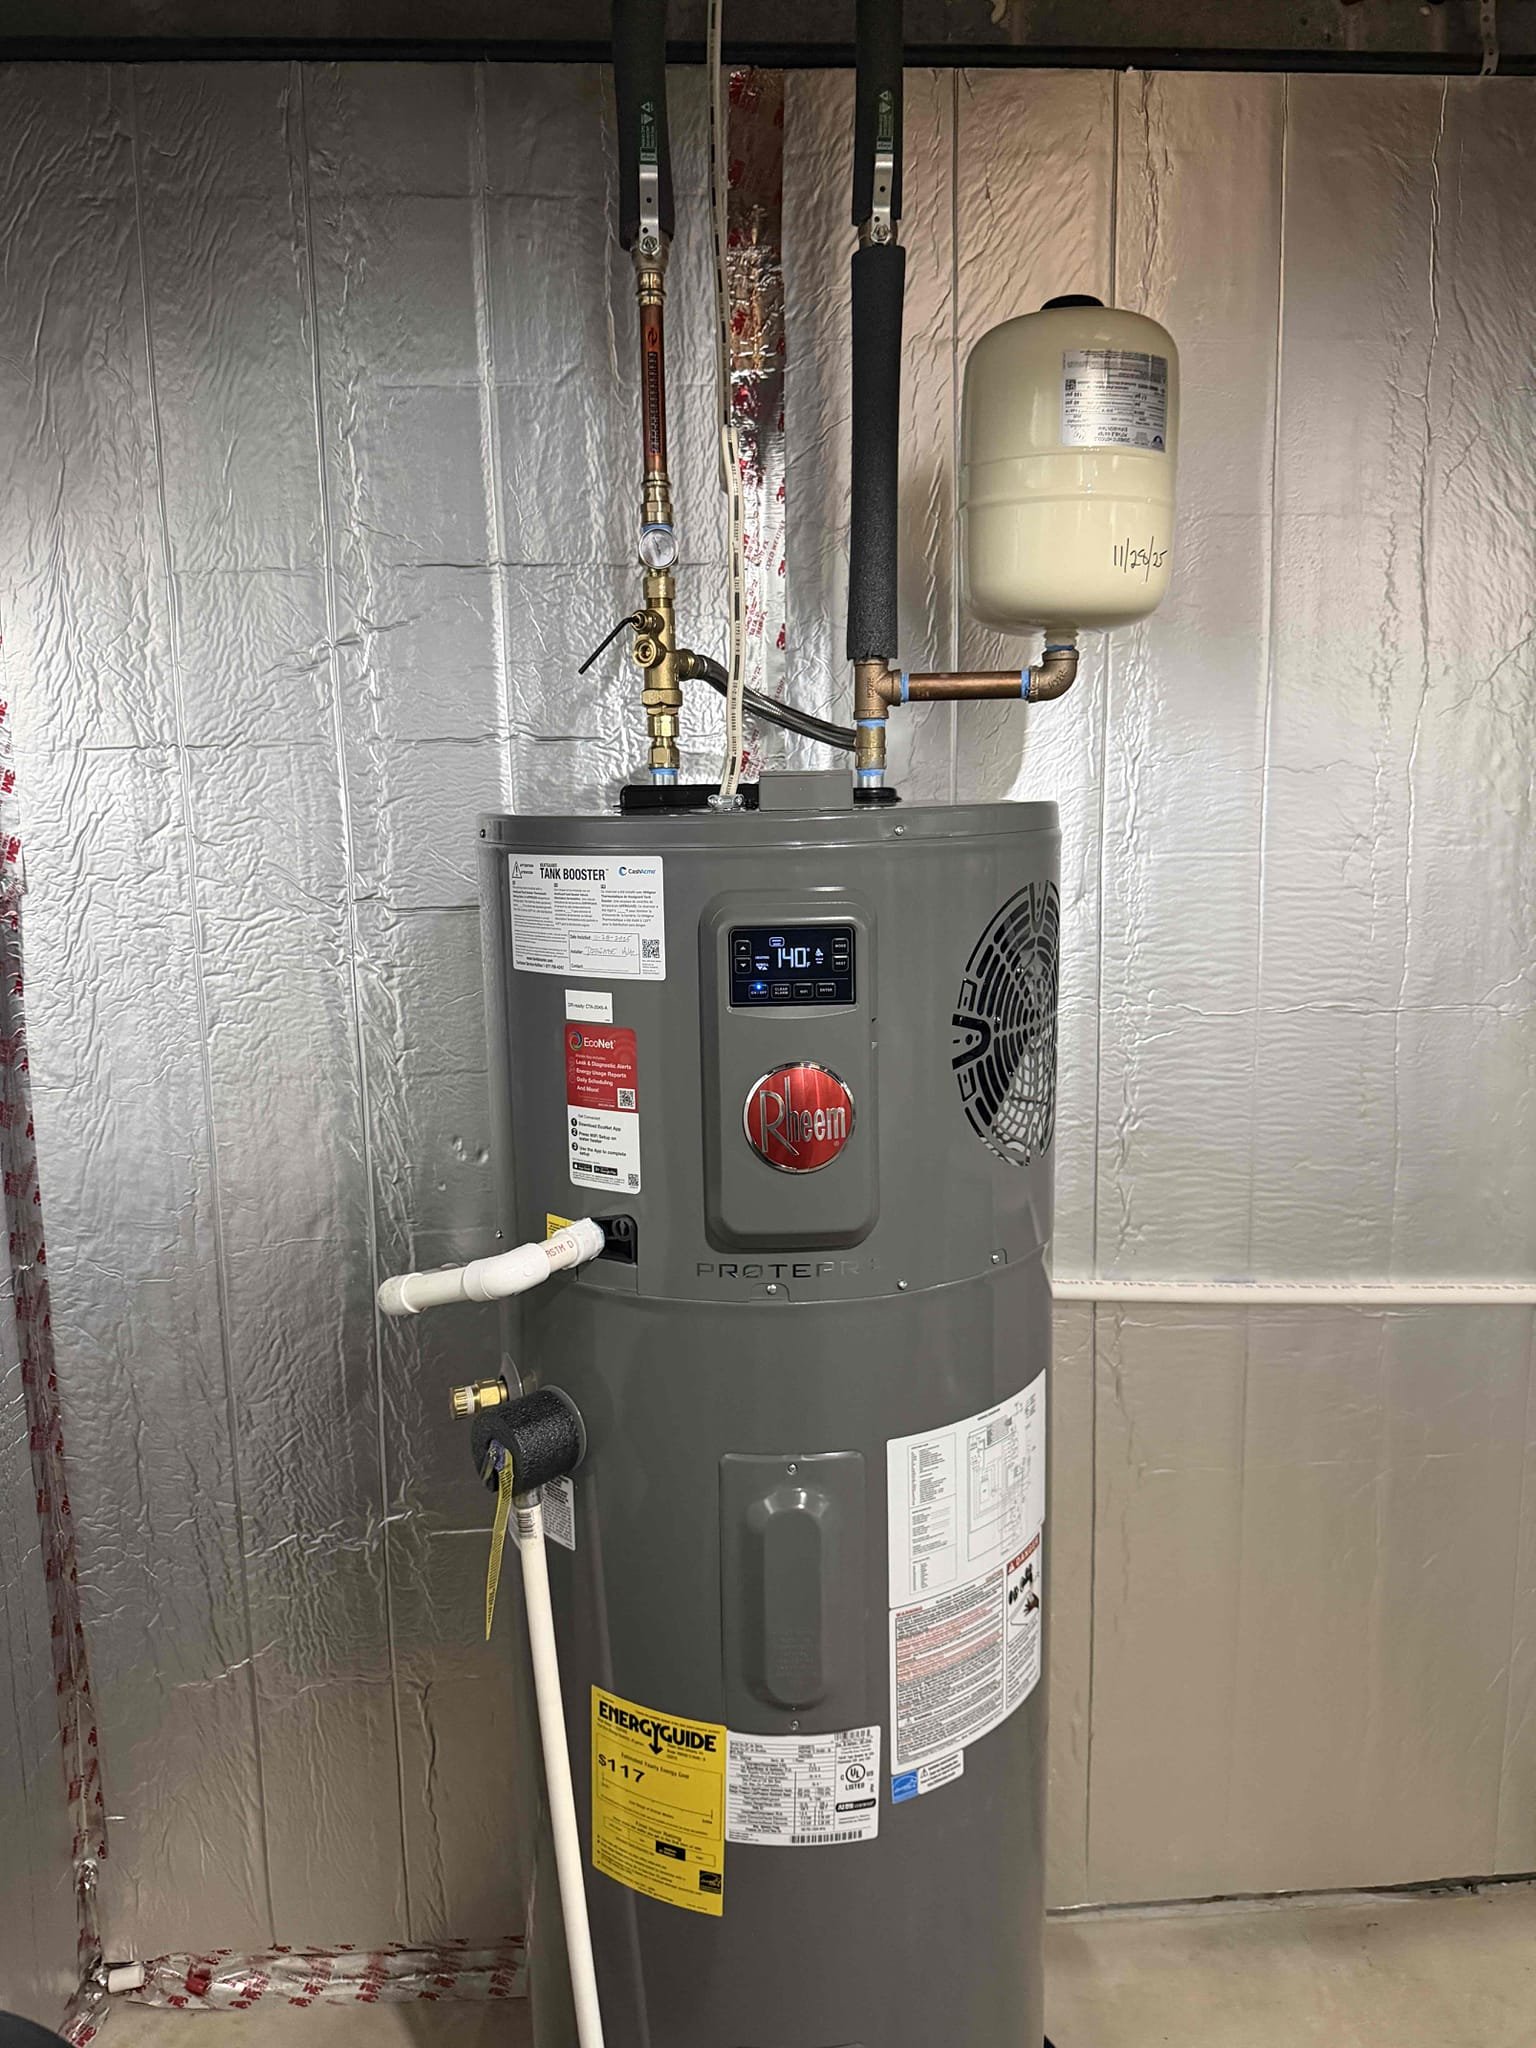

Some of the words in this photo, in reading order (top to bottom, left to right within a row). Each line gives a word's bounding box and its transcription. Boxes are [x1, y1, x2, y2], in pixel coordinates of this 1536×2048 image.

[1113, 535, 1168, 582] 11/28/25
[1, 769, 16, 794] 3M
[7, 836, 21, 863] 3M
[540, 868, 561, 880] TANK
[563, 869, 606, 881] BOOSTER
[583, 1037, 614, 1049] EcoNet
[760, 1075, 847, 1156] Rheem
[598, 1700, 717, 1754] ENERGYGUIDE
[598, 1753, 645, 1783] $117
[850, 1767, 860, 1779] UL
[845, 1782, 865, 1791] LISTED
